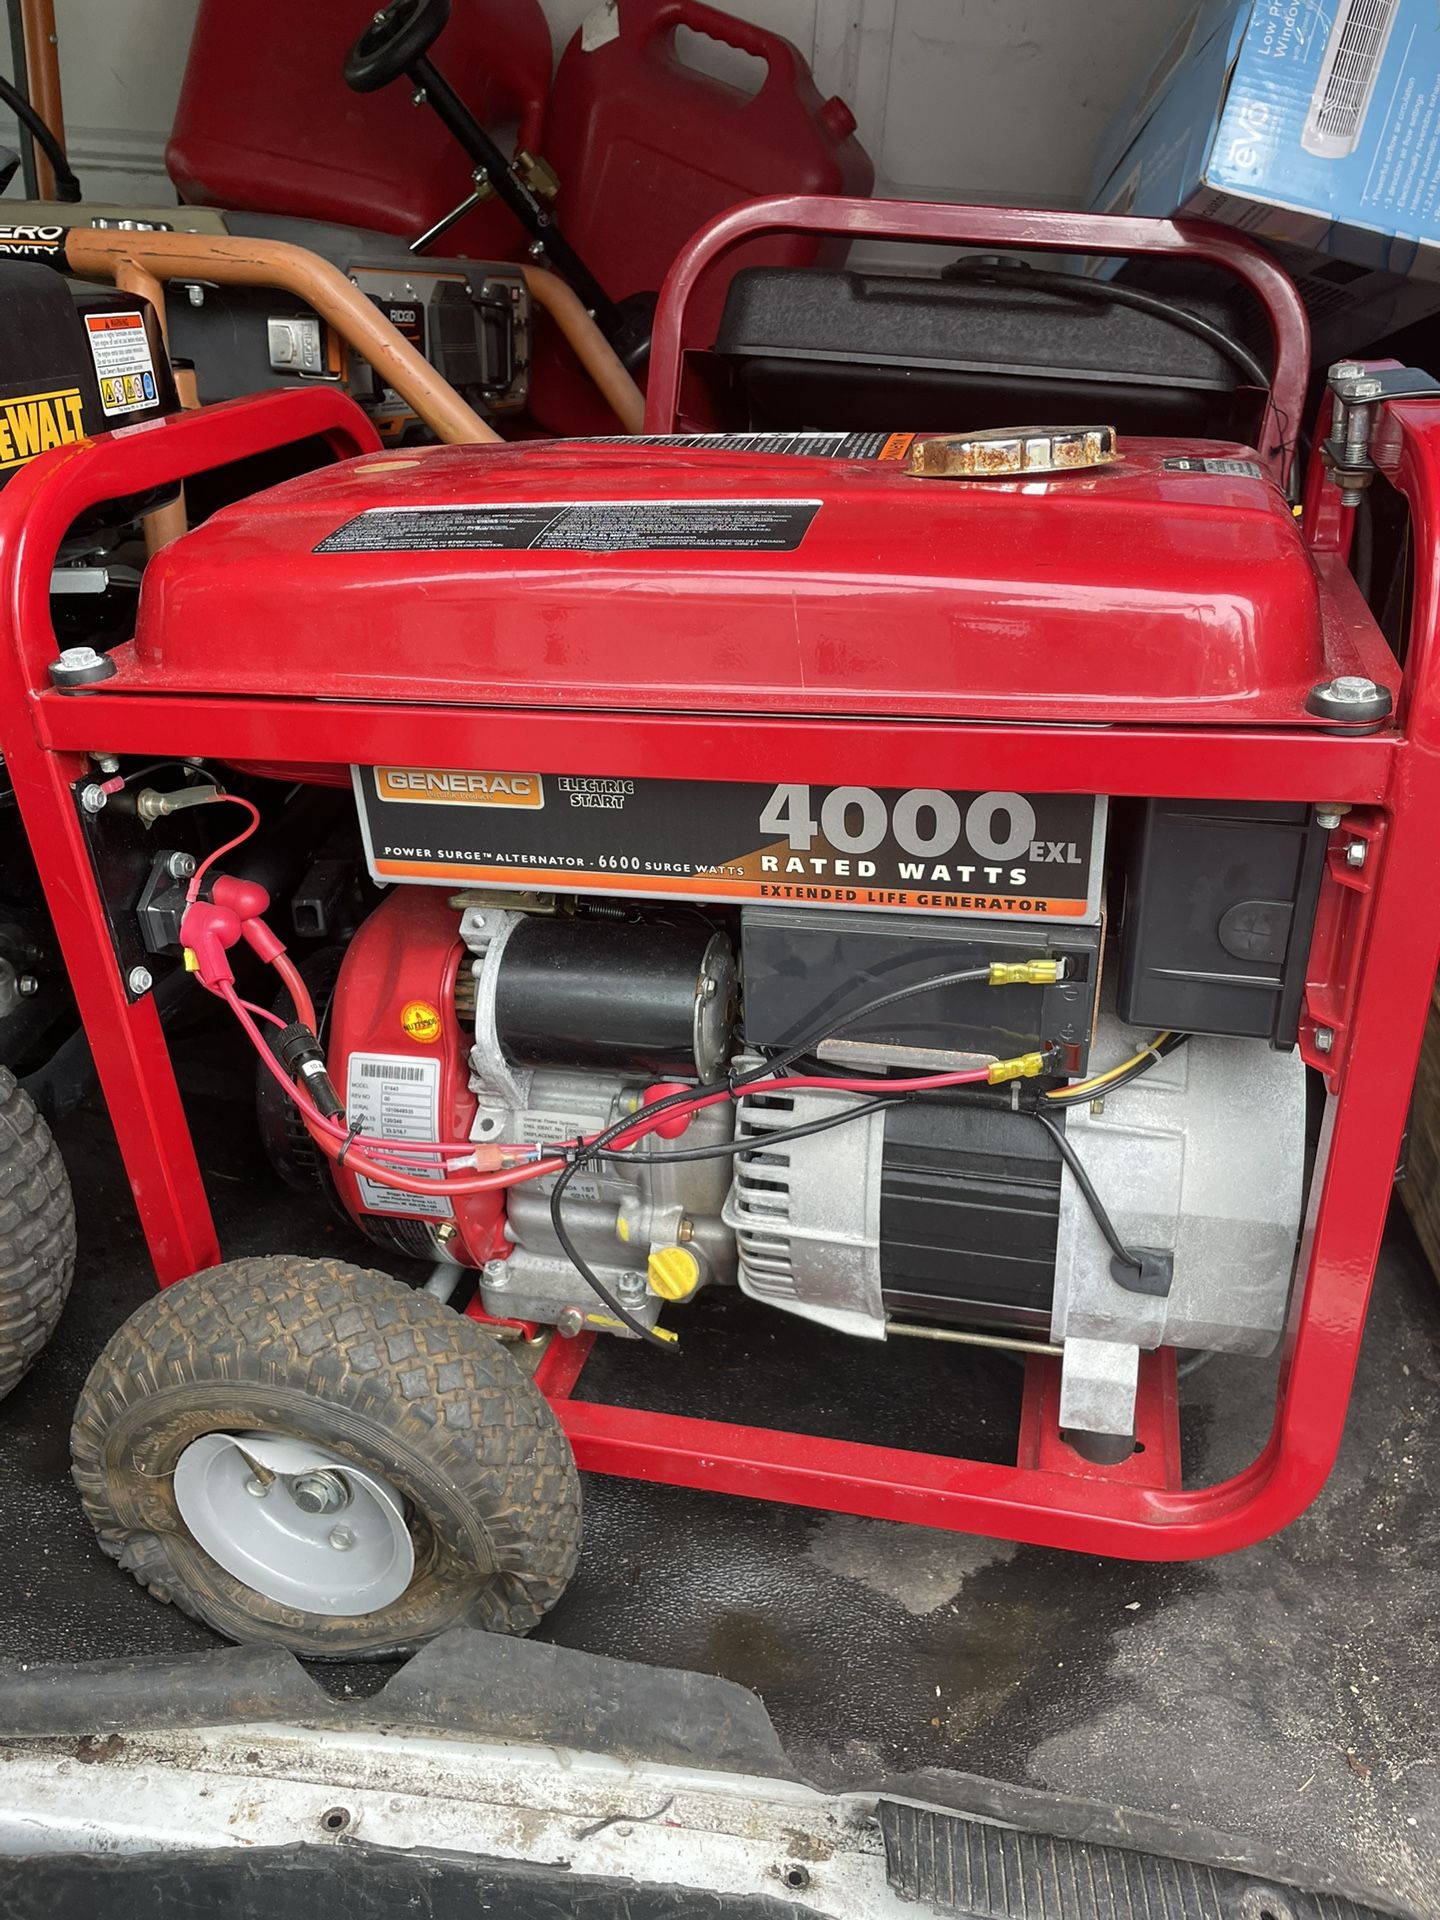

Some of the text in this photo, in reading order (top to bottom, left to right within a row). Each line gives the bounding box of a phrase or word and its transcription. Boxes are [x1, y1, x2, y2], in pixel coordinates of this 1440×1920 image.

[1257, 20, 1277, 55] Low
[389, 308, 417, 323] RIDGID
[387, 771, 530, 796] GENERAC
[557, 777, 635, 795] ELECTRIC
[569, 794, 625, 809] START
[758, 783, 1083, 865] 4000 EXL
[383, 846, 433, 858] POWER
[495, 852, 586, 867] ALTERNATOR
[598, 854, 641, 870] 6600
[644, 861, 692, 873] SURGE
[694, 864, 745, 876] WATTS
[760, 855, 1028, 886] RATED WATTS
[760, 884, 1049, 913] EXTENDED LIFE GENERATOR
